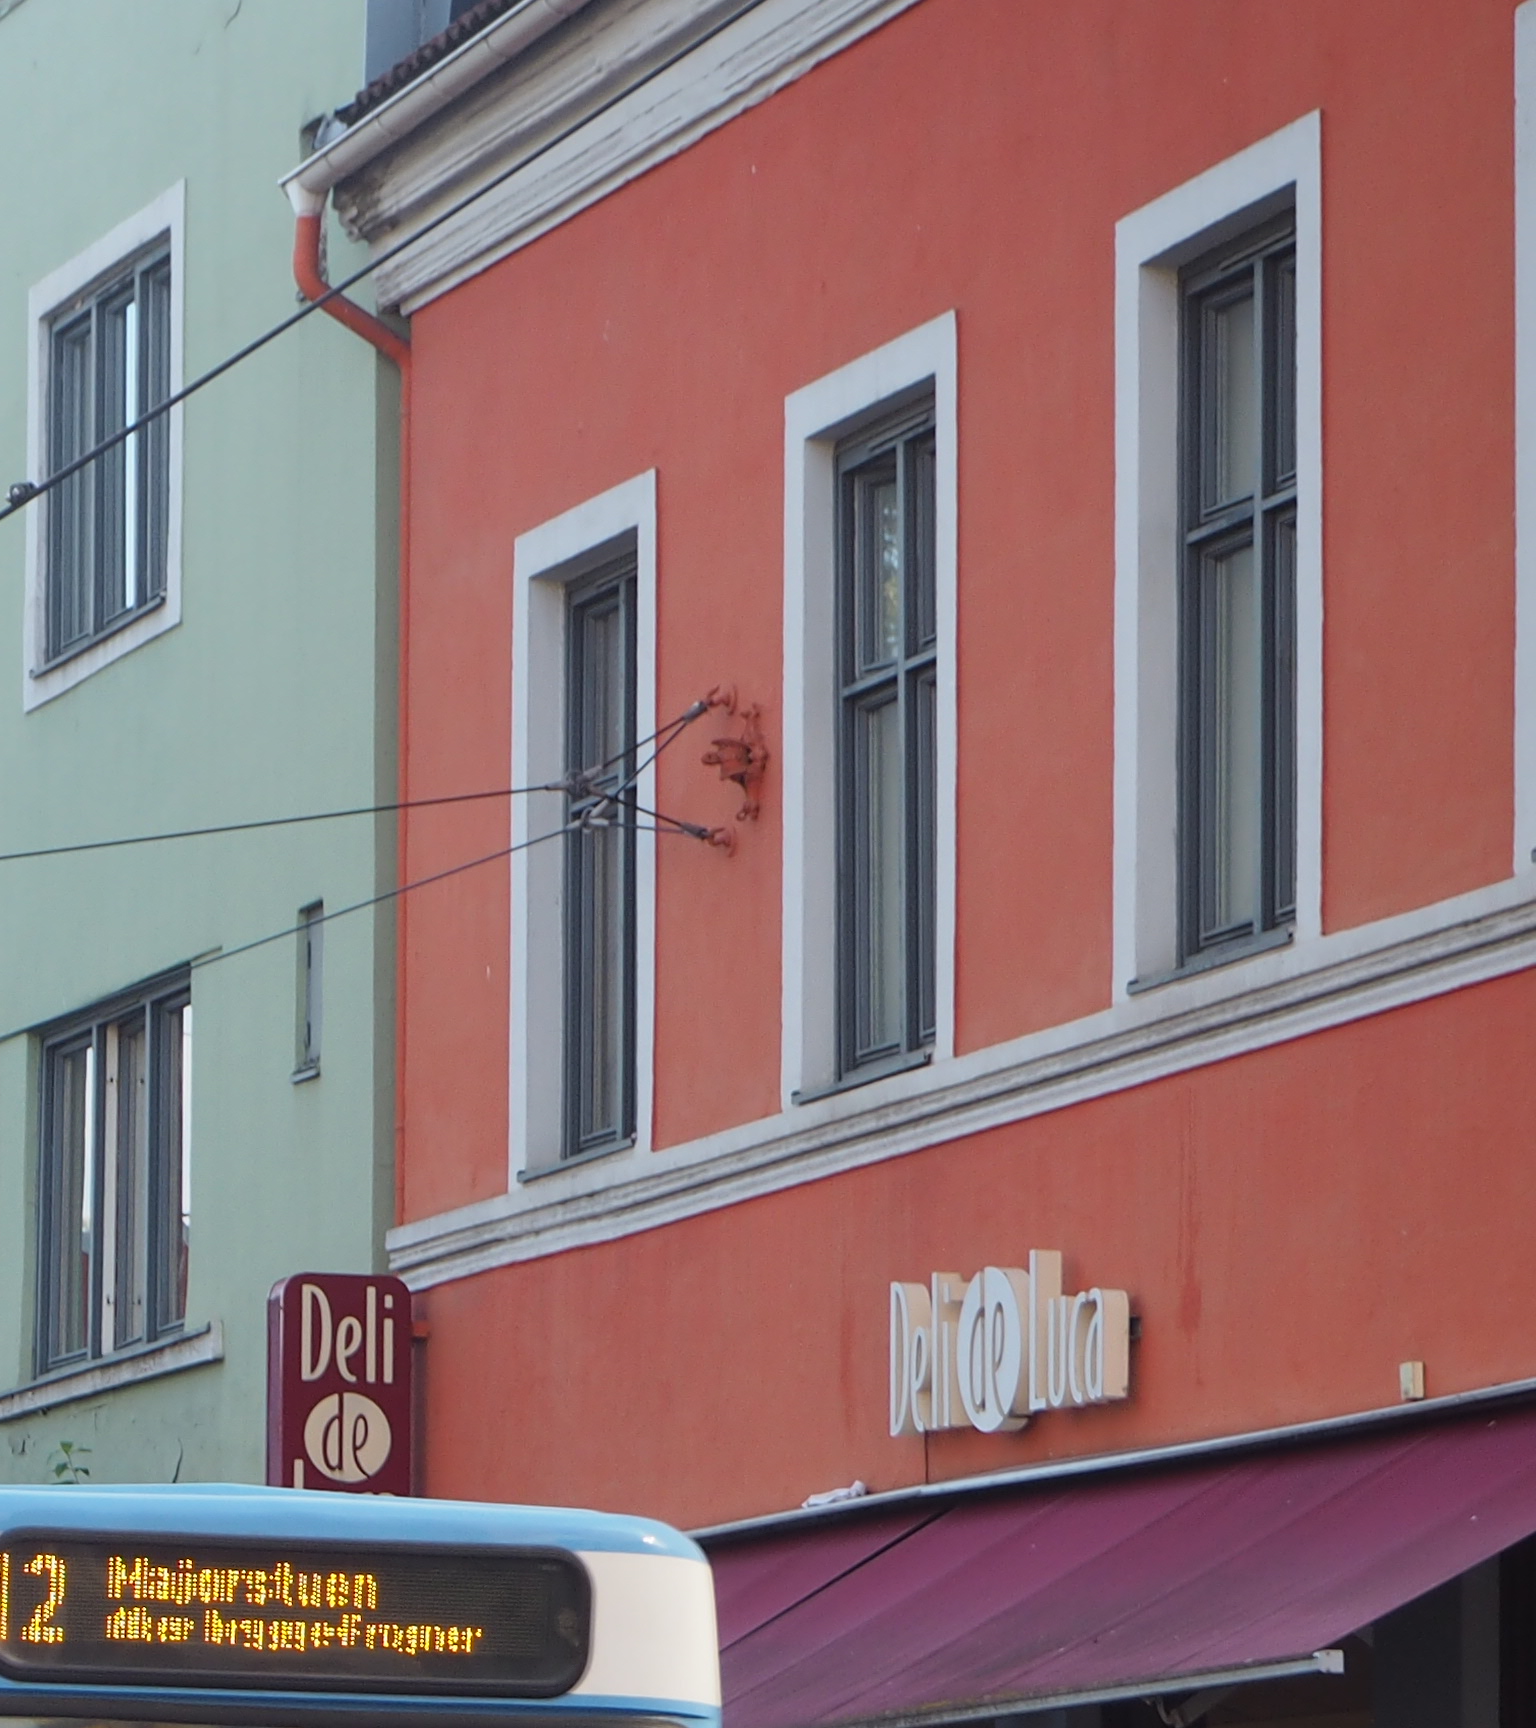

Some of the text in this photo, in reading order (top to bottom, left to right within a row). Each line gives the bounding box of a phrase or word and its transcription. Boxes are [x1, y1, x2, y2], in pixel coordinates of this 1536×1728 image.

[301, 1283, 394, 1384] Deli
[890, 1249, 1108, 1437] Deli de Luca
[315, 1392, 378, 1481] de
[106, 1555, 378, 1610] Majorstuen
